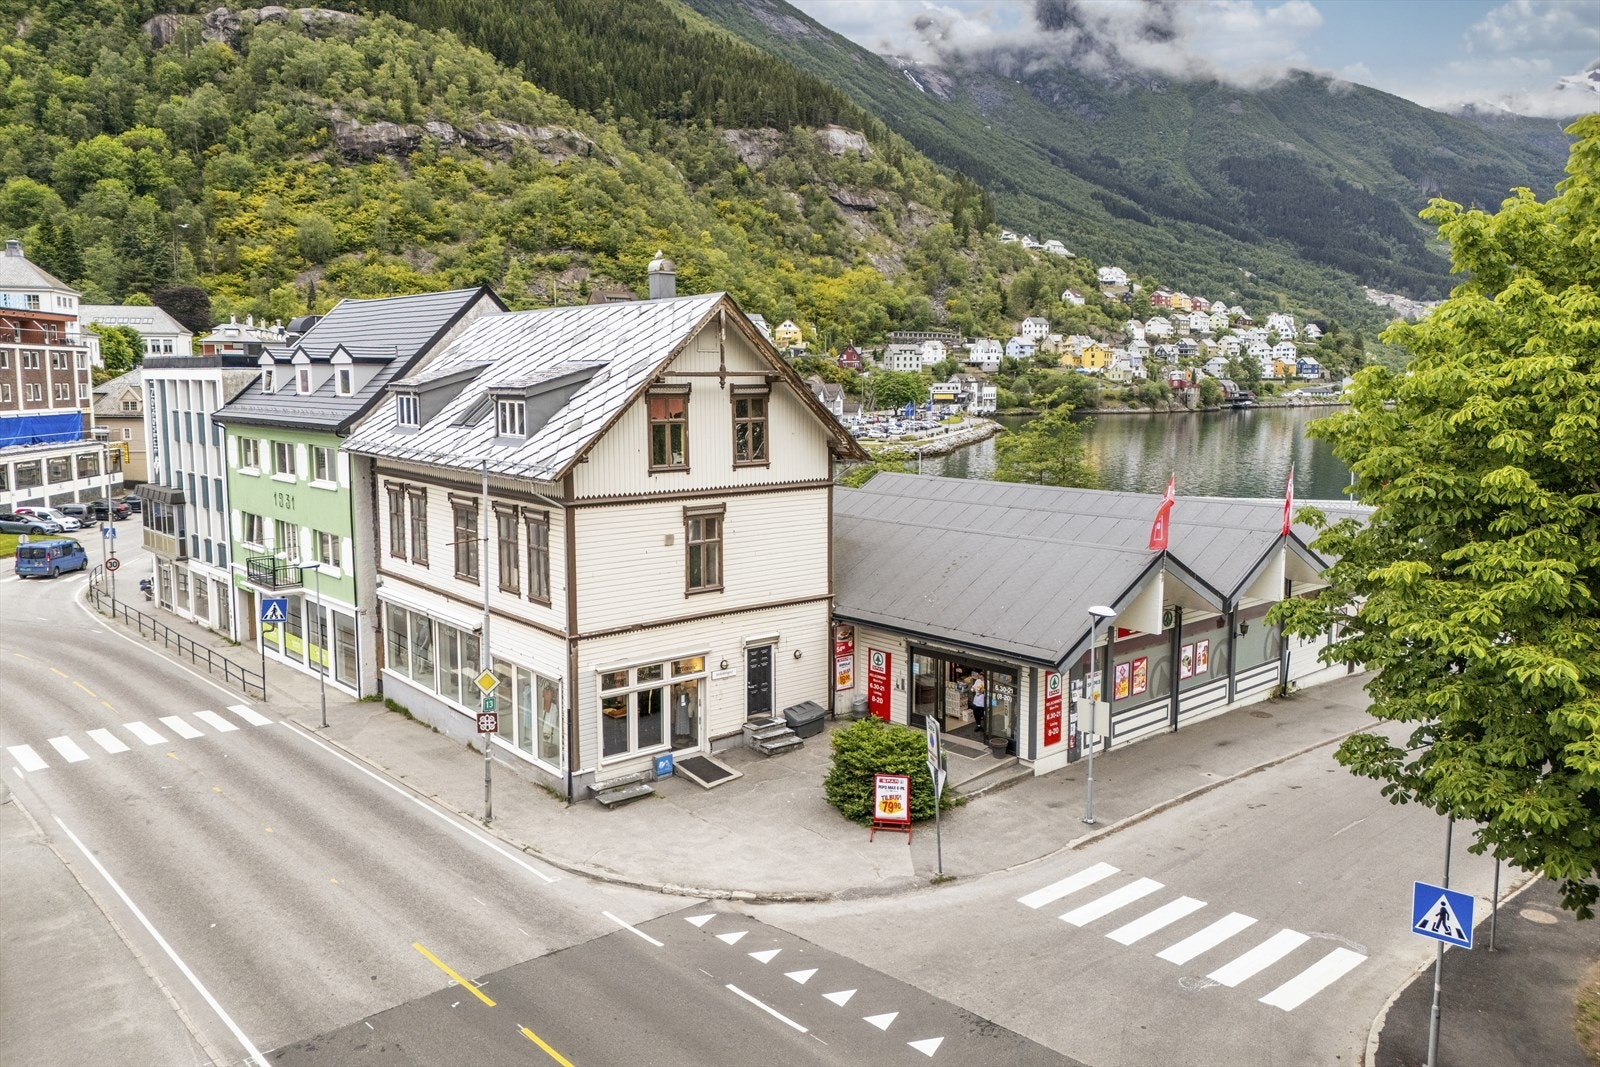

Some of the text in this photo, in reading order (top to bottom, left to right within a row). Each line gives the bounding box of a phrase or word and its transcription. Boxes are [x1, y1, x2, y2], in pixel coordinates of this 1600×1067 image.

[273, 491, 296, 511] 1931
[108, 560, 118, 568] 30
[485, 699, 494, 709] 13
[871, 695, 884, 704] 8-20
[1047, 727, 1059, 737] 8-20
